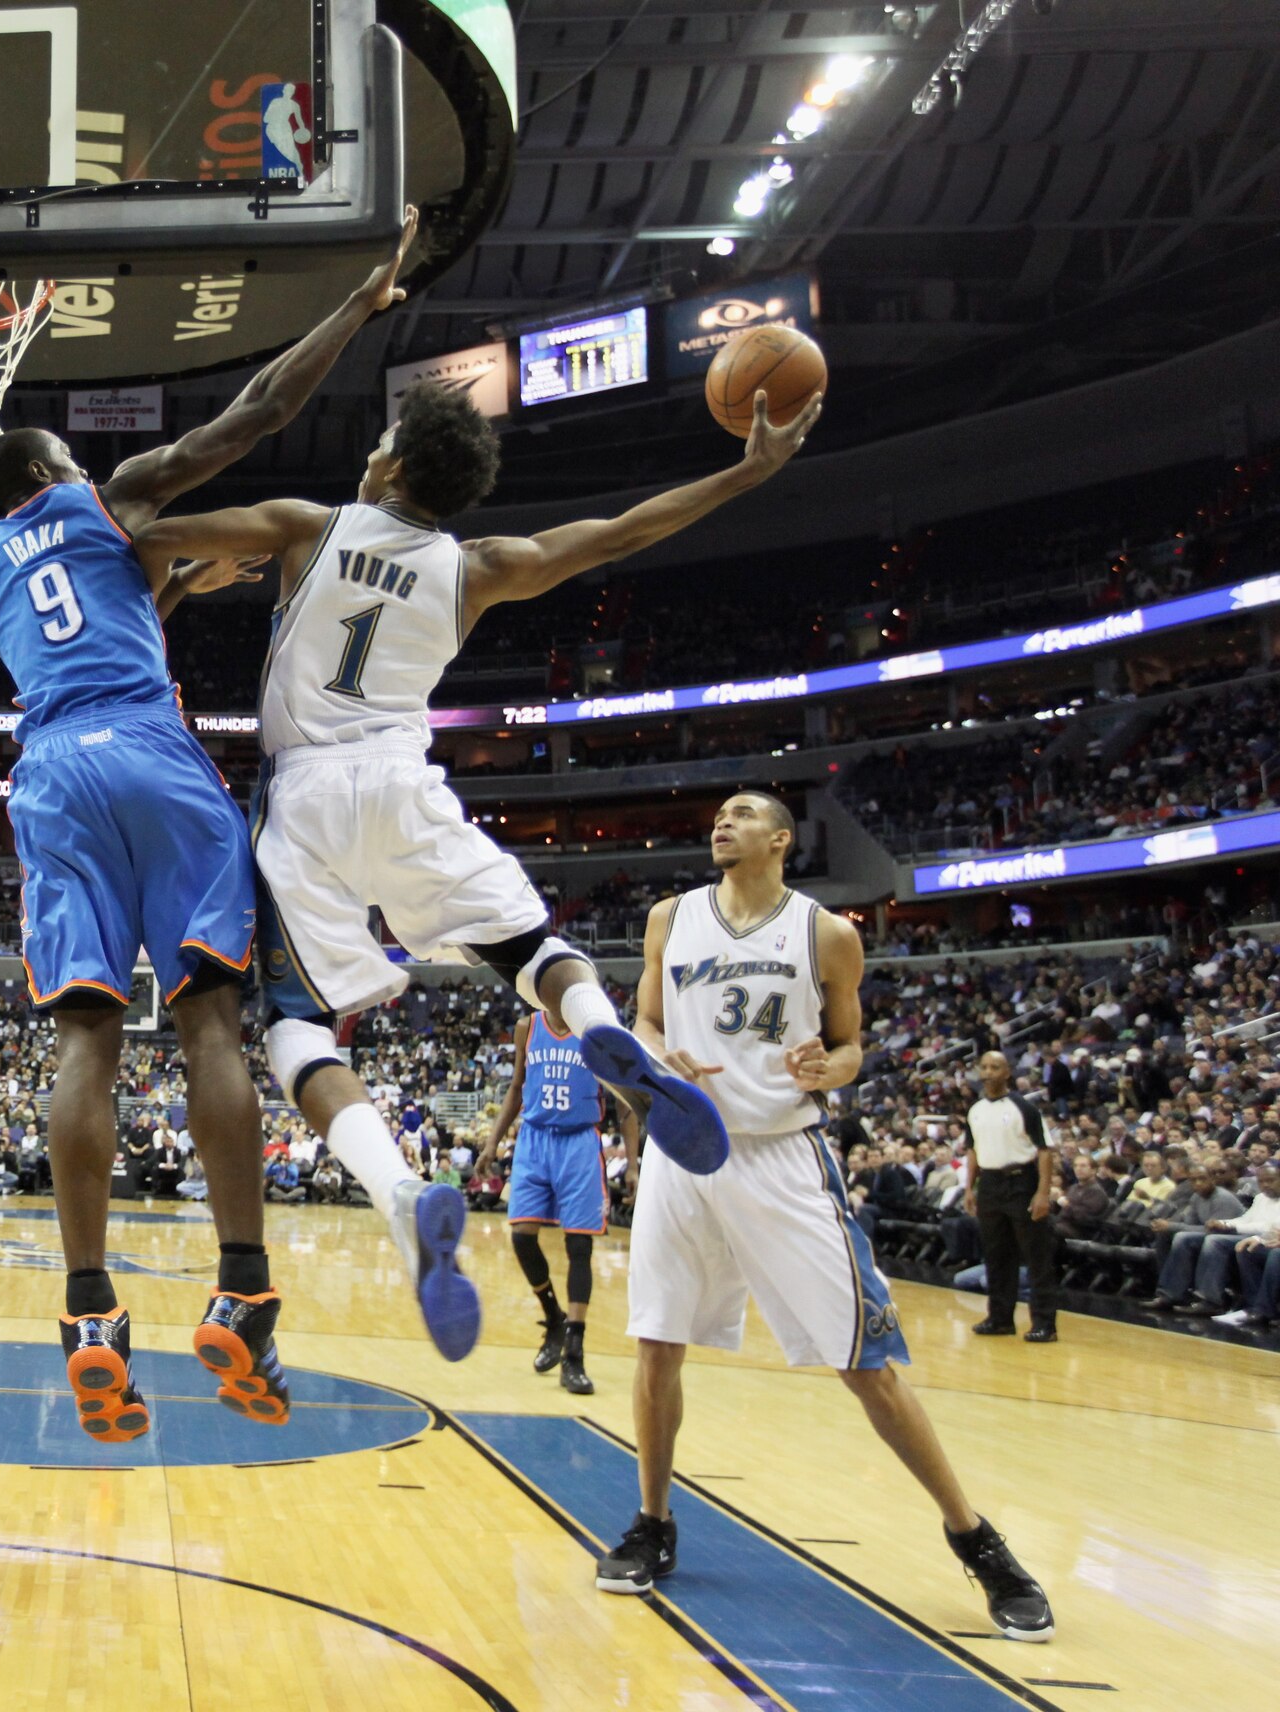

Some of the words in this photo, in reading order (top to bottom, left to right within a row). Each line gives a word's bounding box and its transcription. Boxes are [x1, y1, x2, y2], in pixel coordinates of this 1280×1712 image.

[412, 356, 499, 380] AMTRAK
[94, 417, 136, 428] 1977-78
[3, 520, 65, 567] IBAKA
[338, 549, 418, 600] YOUNG
[26, 562, 85, 643] 9
[323, 602, 385, 699] 1
[195, 717, 259, 732] THUNDER
[503, 706, 547, 724] 7:22
[79, 728, 113, 746] THUNDER
[714, 984, 789, 1045] 34
[544, 1065, 570, 1080] CITY
[541, 1084, 570, 1111] 35
